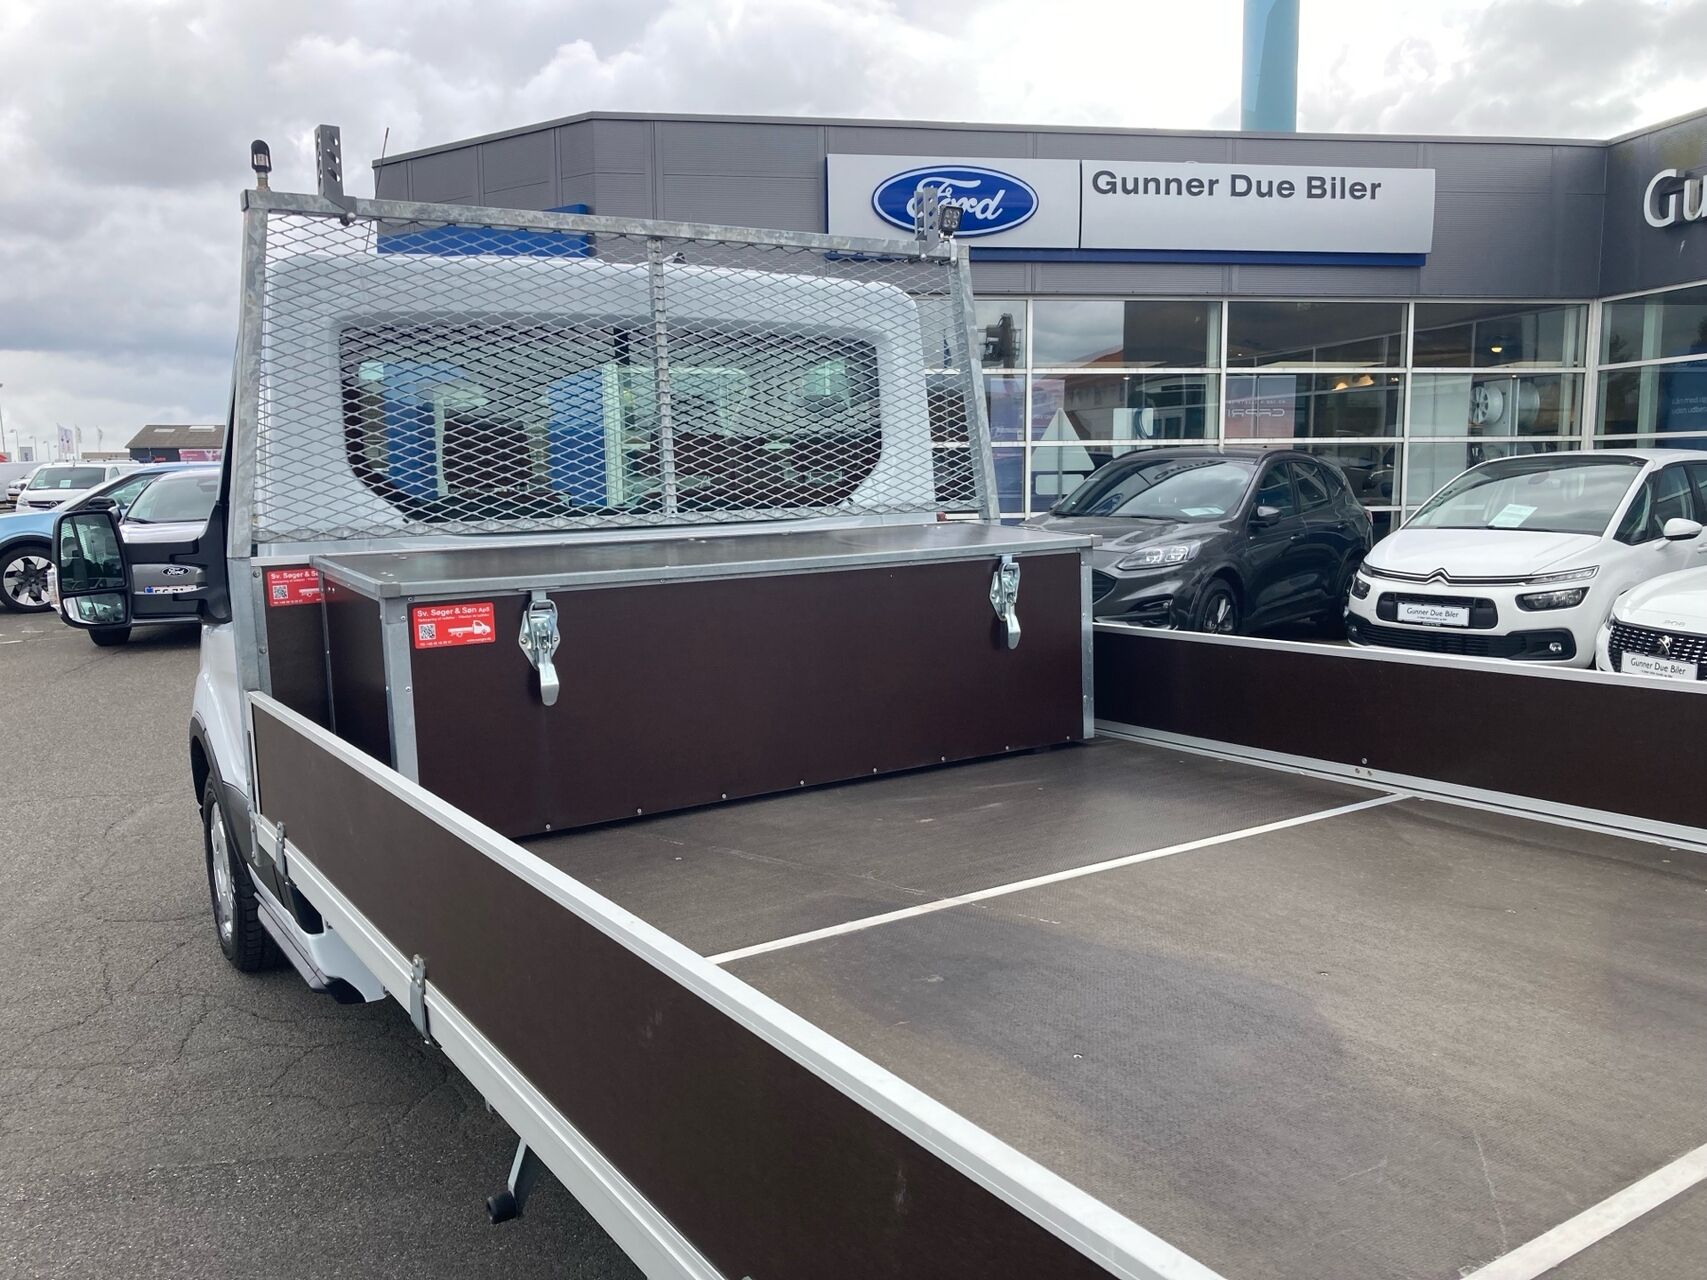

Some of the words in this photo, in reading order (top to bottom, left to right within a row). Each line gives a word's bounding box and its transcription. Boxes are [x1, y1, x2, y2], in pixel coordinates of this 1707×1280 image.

[1092, 169, 1219, 198] Gunner
[1230, 172, 1295, 199] Due
[1306, 174, 1382, 201] Biler
[1406, 607, 1429, 616] Gunner
[1430, 609, 1443, 617] Due
[1444, 610, 1459, 618] Biler
[1630, 658, 1653, 669] Gunner
[1654, 662, 1668, 672] Due
[1670, 664, 1686, 675] Biler
